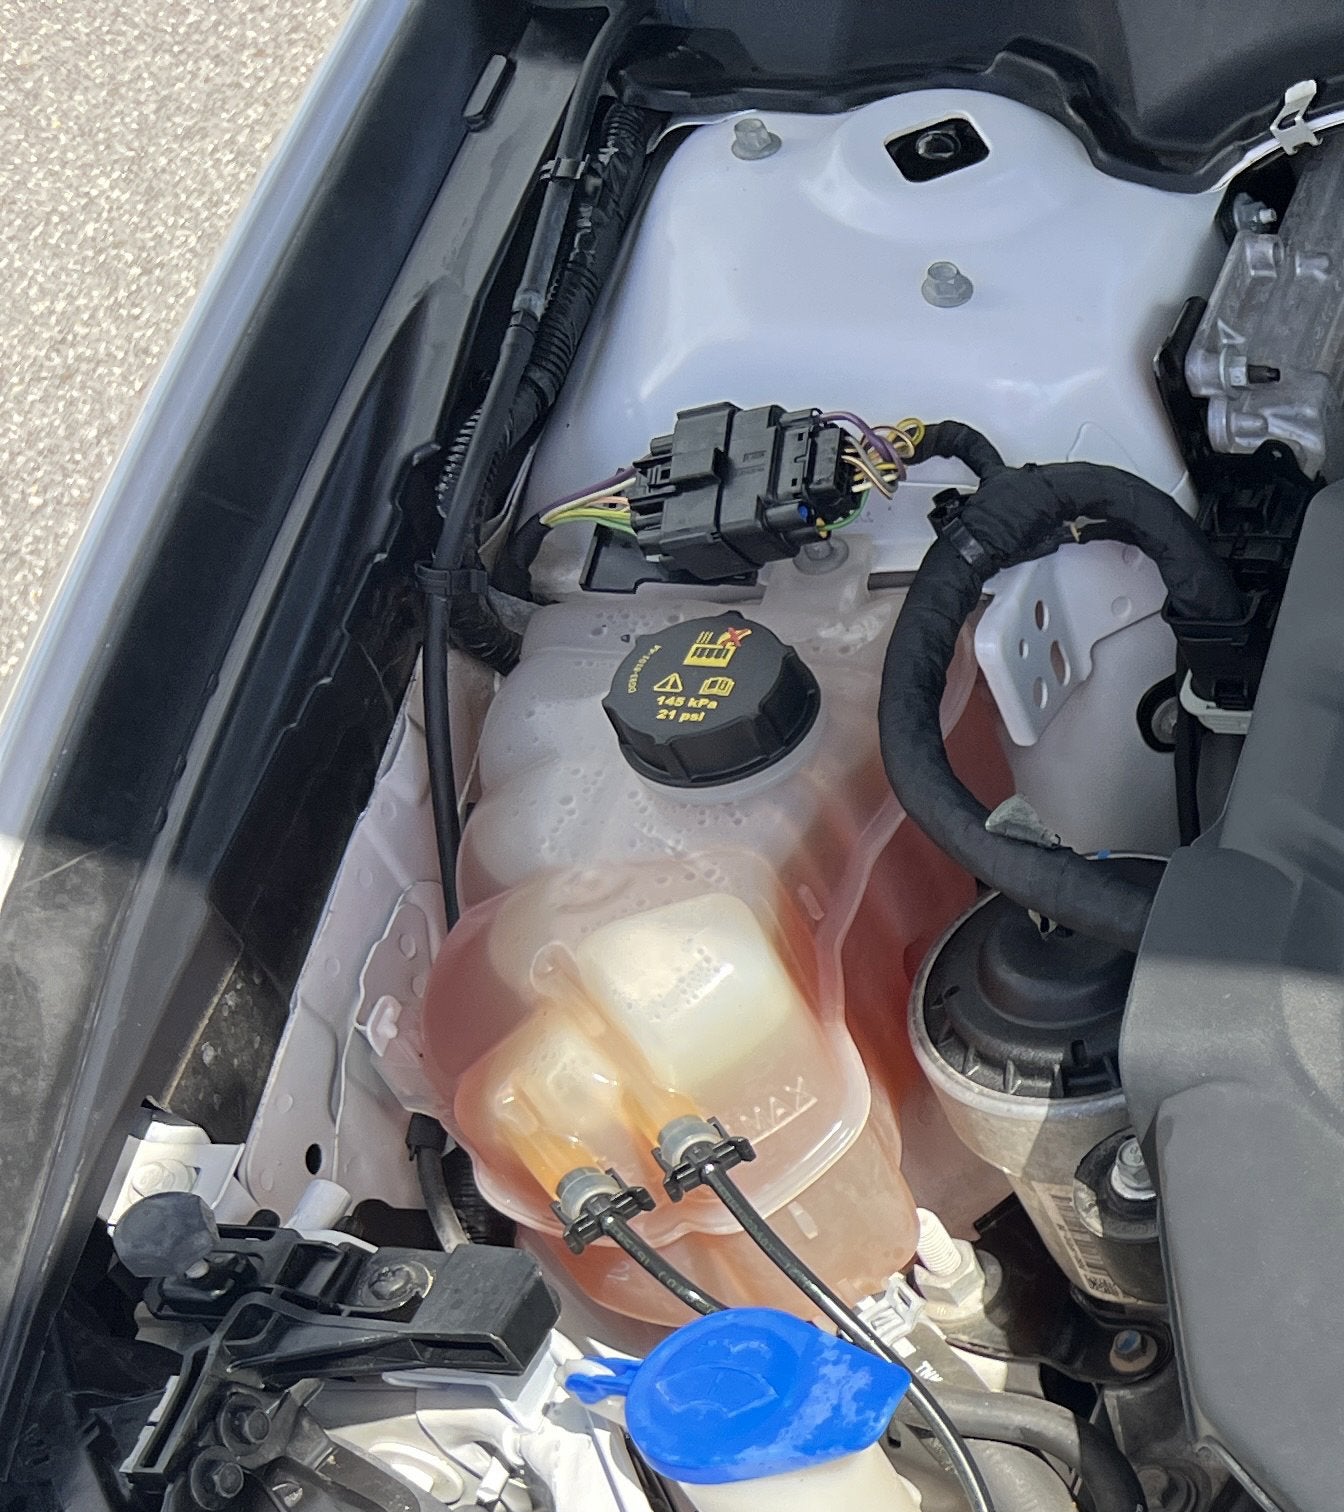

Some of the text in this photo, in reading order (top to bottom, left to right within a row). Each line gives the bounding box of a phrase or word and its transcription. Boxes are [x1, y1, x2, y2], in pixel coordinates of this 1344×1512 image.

[656, 695, 718, 710] 145 kPa
[656, 709, 706, 723] 21 psi
